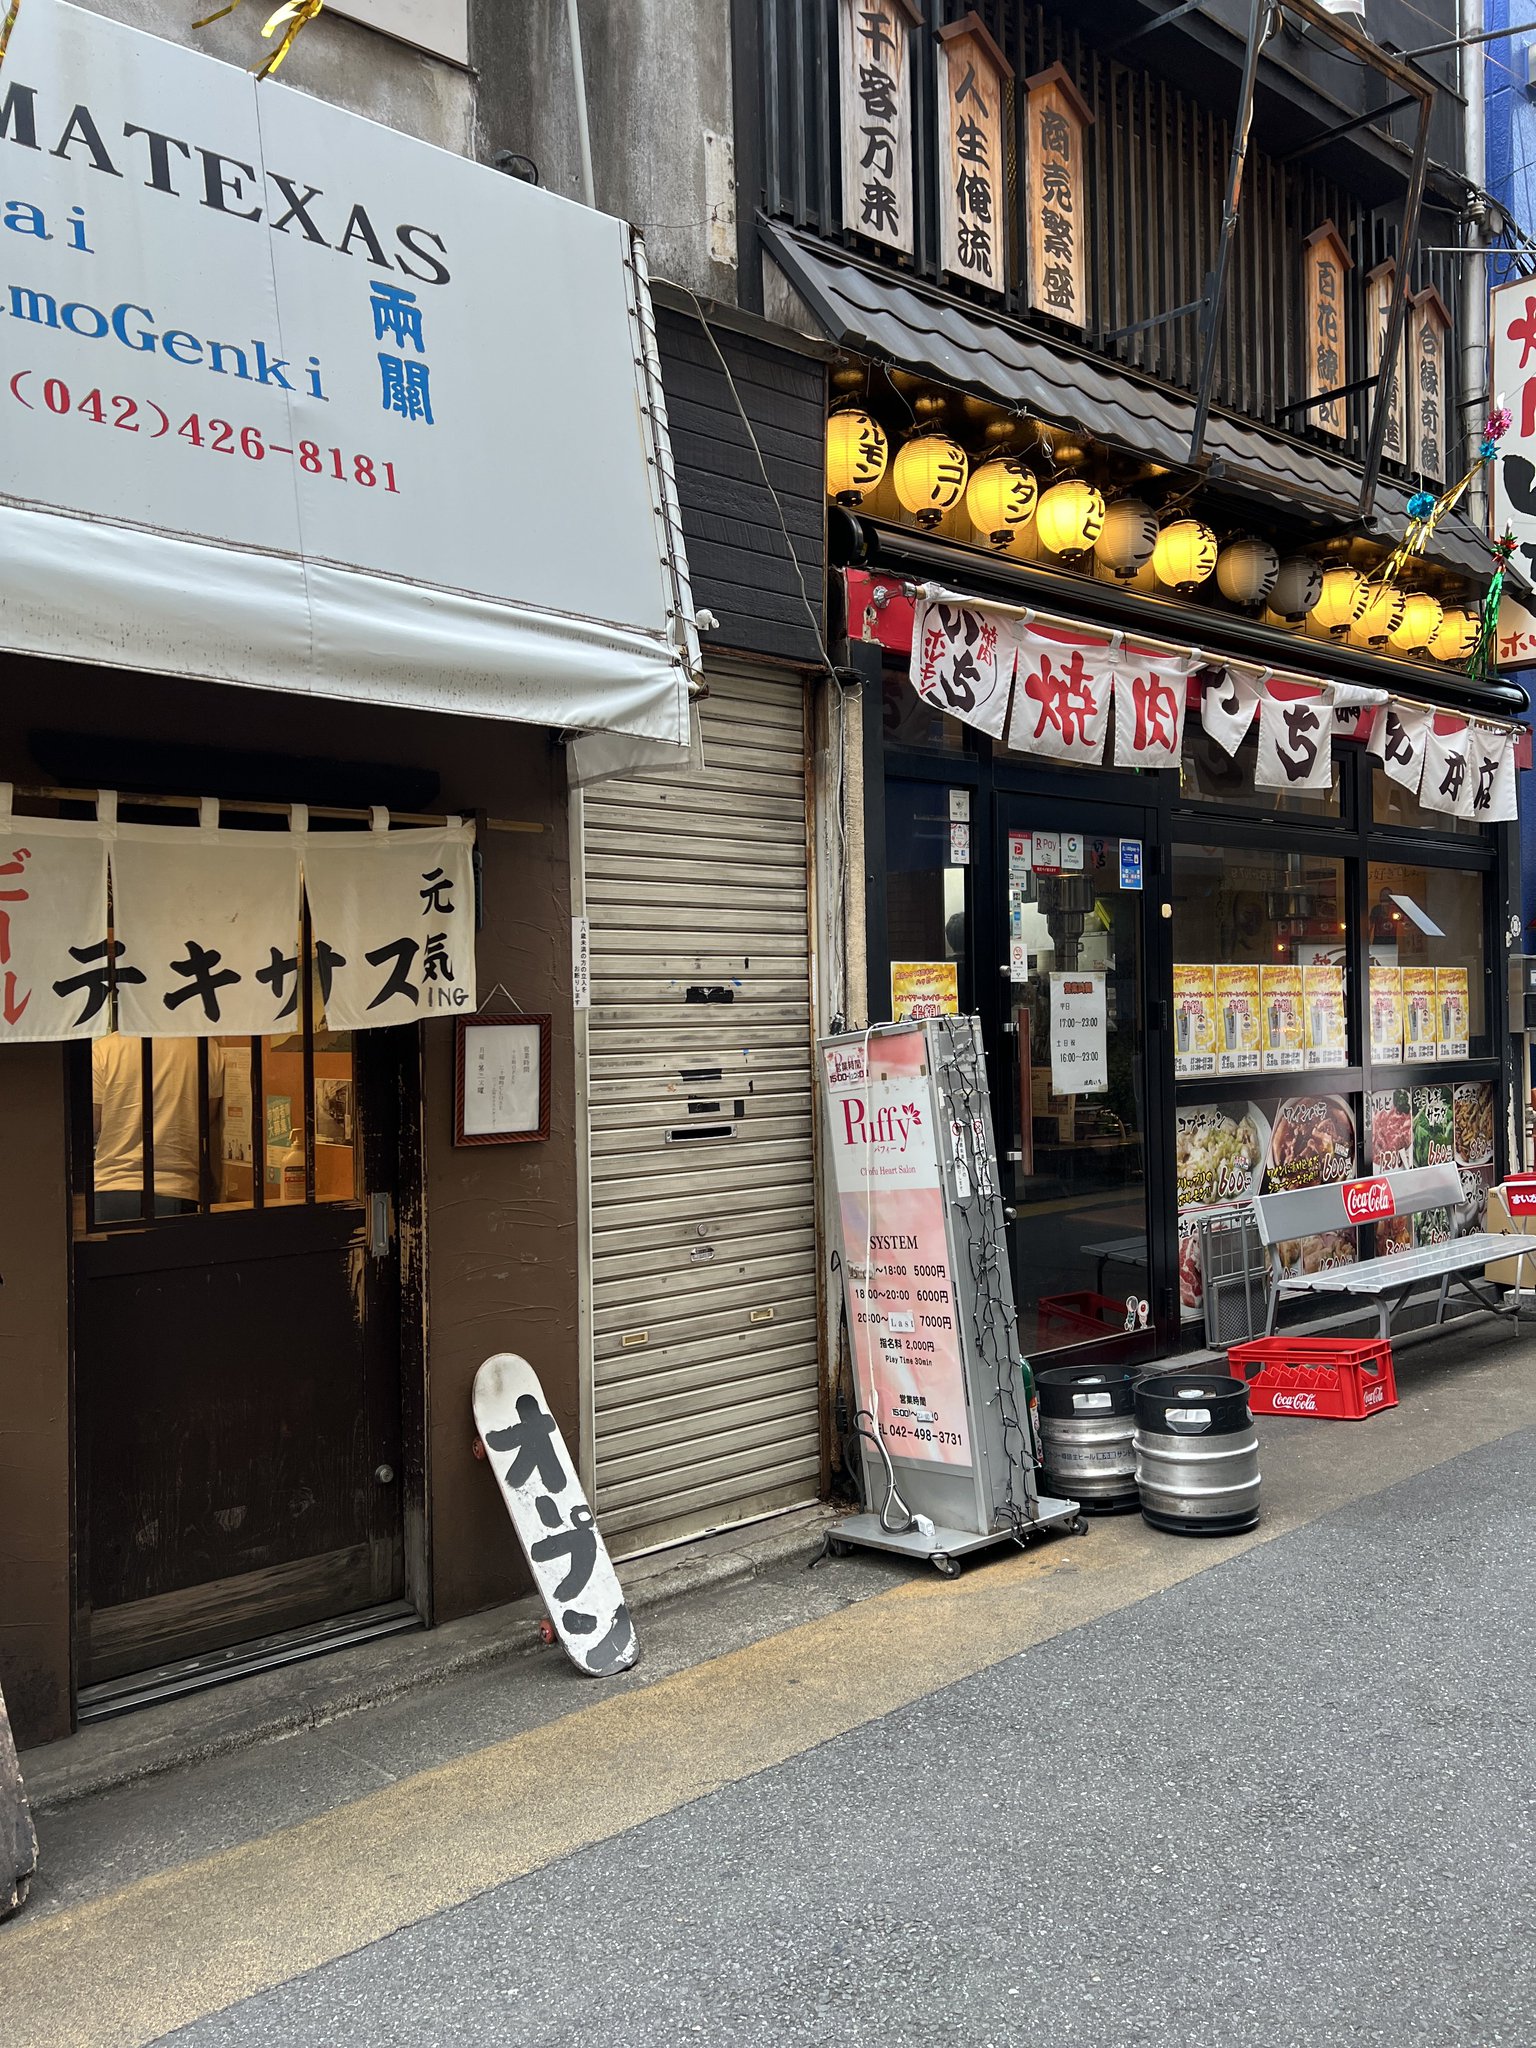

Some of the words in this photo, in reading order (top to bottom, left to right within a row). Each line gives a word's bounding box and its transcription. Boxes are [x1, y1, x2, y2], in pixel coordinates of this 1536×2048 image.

[857, 11, 899, 237] 千客万来
[955, 60, 992, 278] 人生俺流
[1040, 105, 1075, 314] 商売繁盛
[0, 200, 95, 255] ai
[0, 284, 330, 402] moGenki
[419, 867, 455, 985] 元気
[52, 937, 421, 1027] テキサス
[426, 986, 470, 1009] ING
[839, 1098, 912, 1153] Puffy
[880, 1166, 898, 1175] Heart
[898, 1165, 917, 1175] Salon
[869, 1235, 919, 1250] SYSTEM
[913, 1265, 946, 1279] 5000円
[855, 1288, 910, 1301] 1800～20:00
[916, 1290, 949, 1304] 6000円
[919, 1315, 952, 1330] 7000円
[879, 1337, 903, 1349] 指名料
[905, 1339, 935, 1353] 2,000円
[885, 1355, 898, 1364] Play
[899, 1356, 913, 1365] Time
[899, 1394, 927, 1407] 営業時間
[1272, 1391, 1318, 1412] Coca-Cola
[1363, 1385, 1385, 1406] Coca-Cola
[889, 1424, 962, 1446] 042-498-3731
[485, 1393, 631, 1671] オープン
